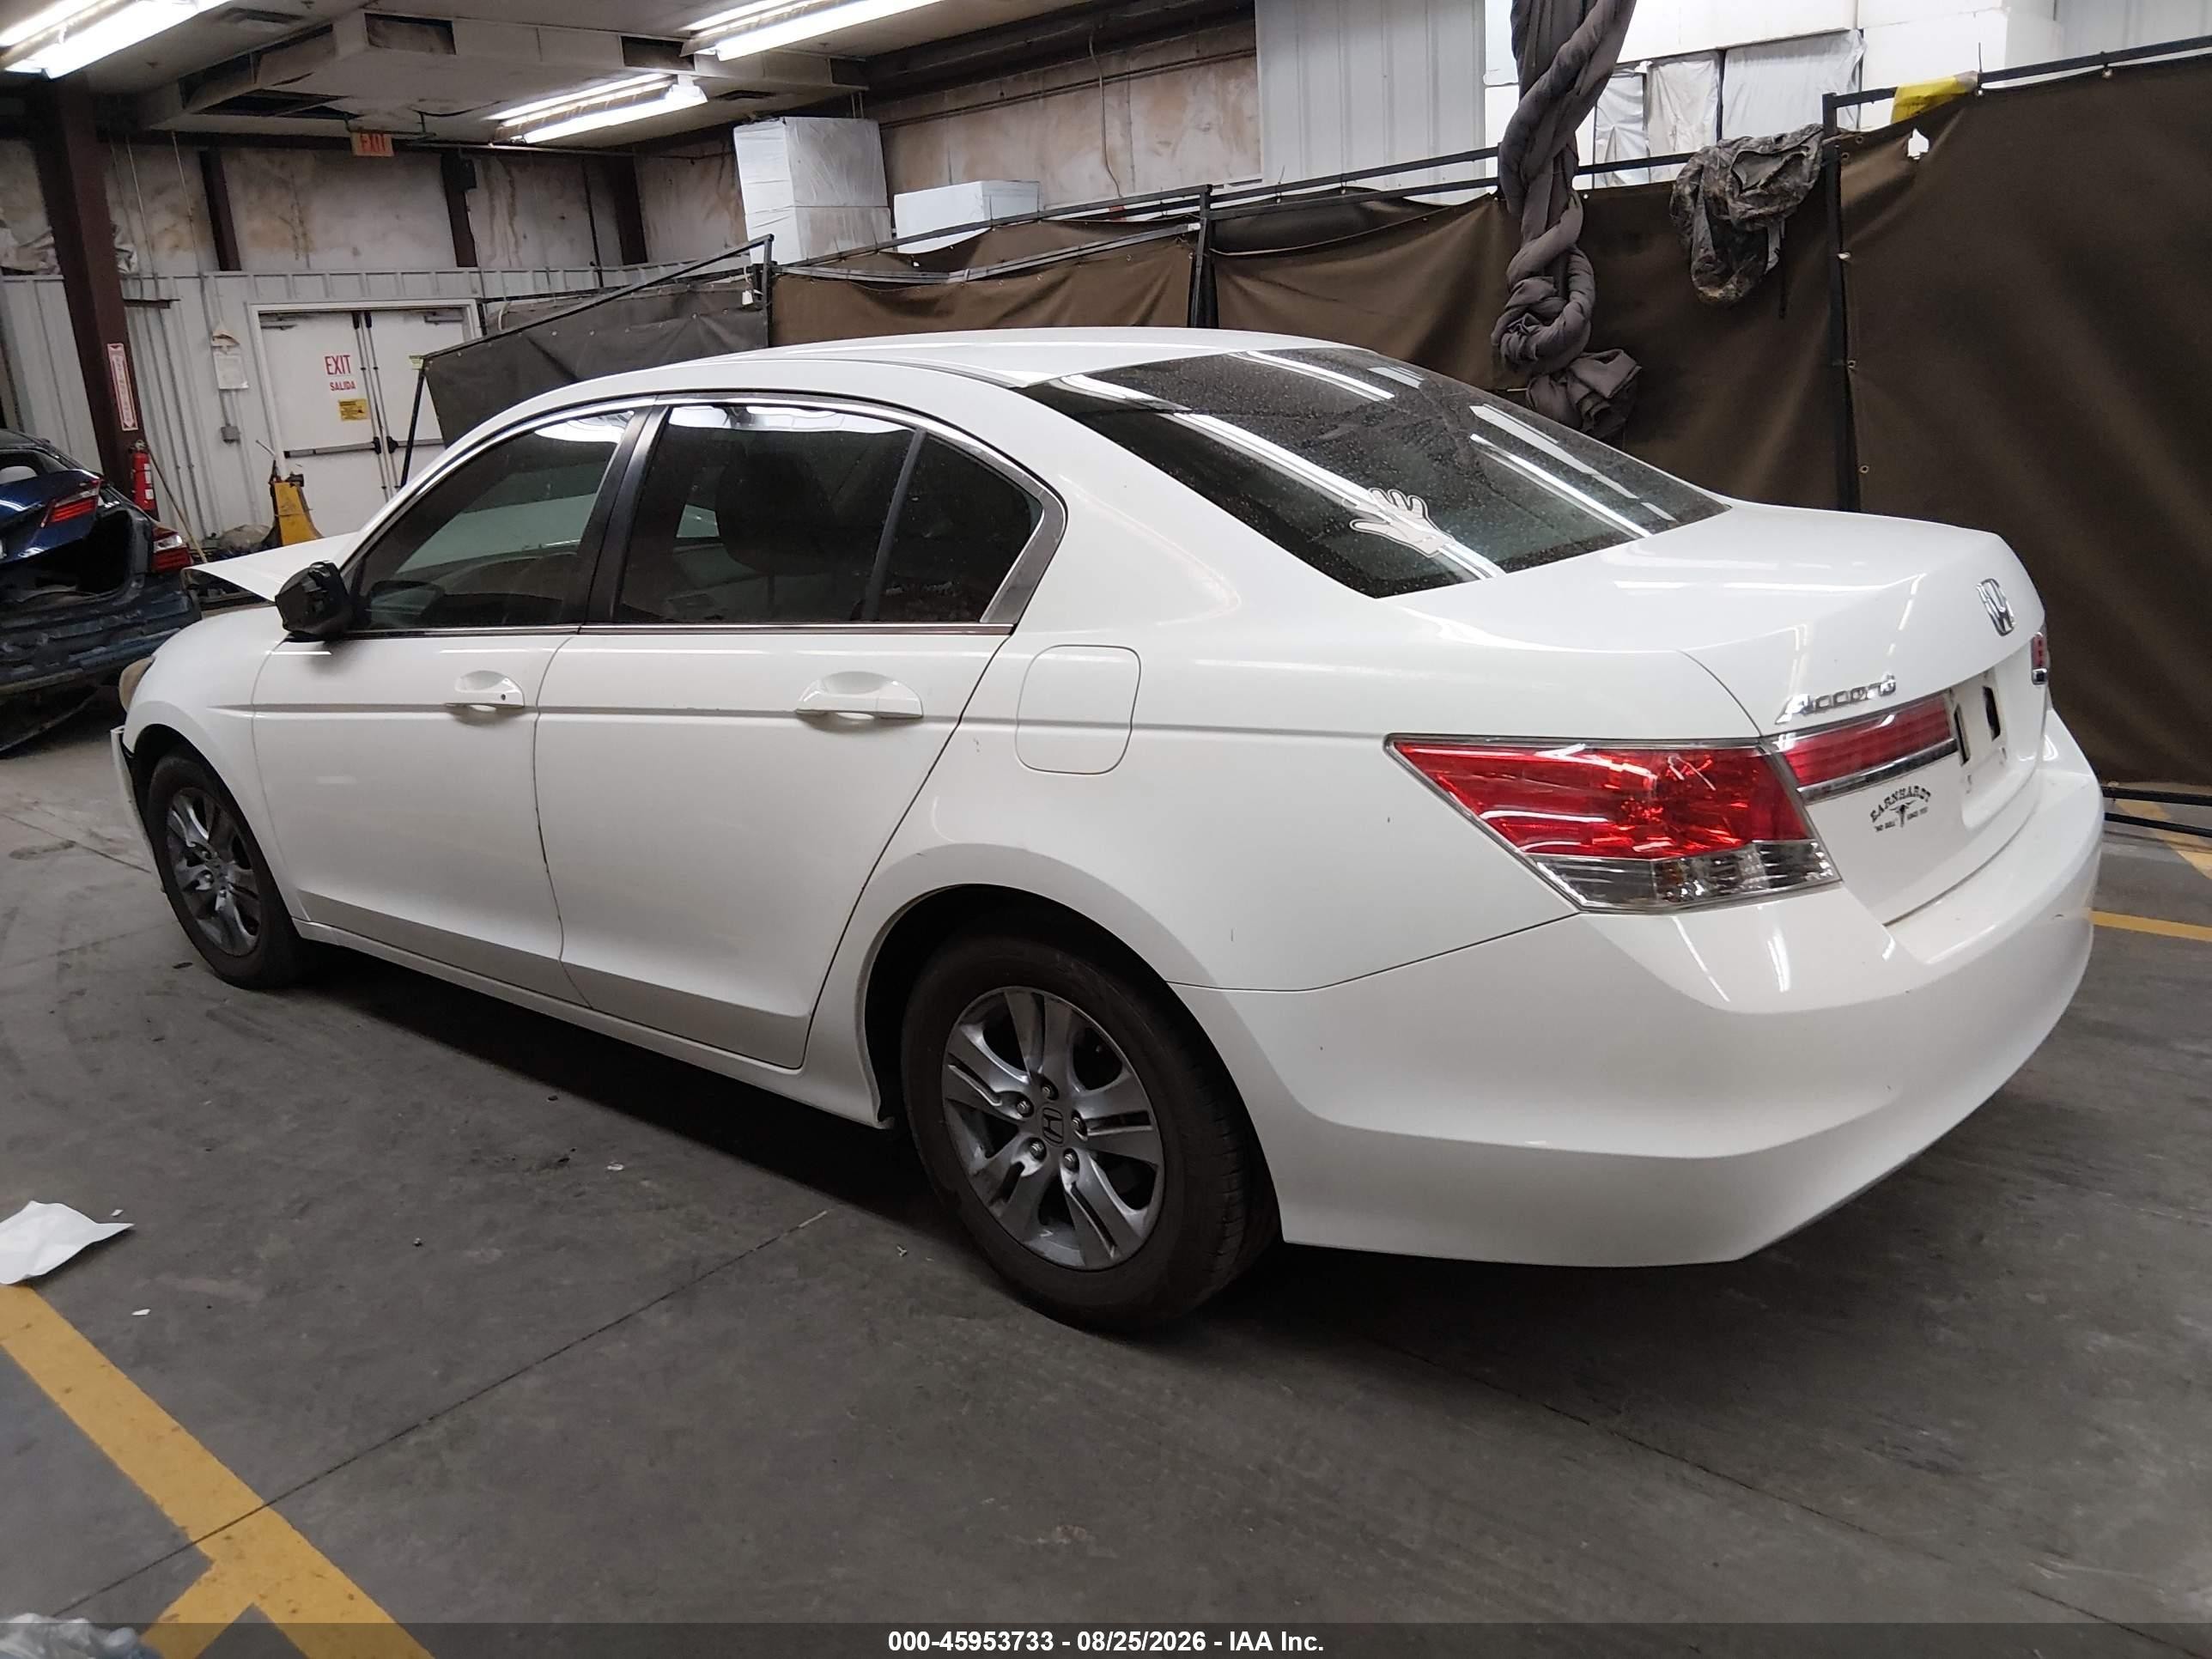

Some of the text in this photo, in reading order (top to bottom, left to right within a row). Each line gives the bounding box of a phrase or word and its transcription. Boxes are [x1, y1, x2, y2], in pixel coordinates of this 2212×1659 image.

[360, 132, 386, 152] EXIT
[325, 355, 351, 375] EXIT
[330, 380, 356, 391] SALIDA
[1775, 673, 1896, 725] Accord
